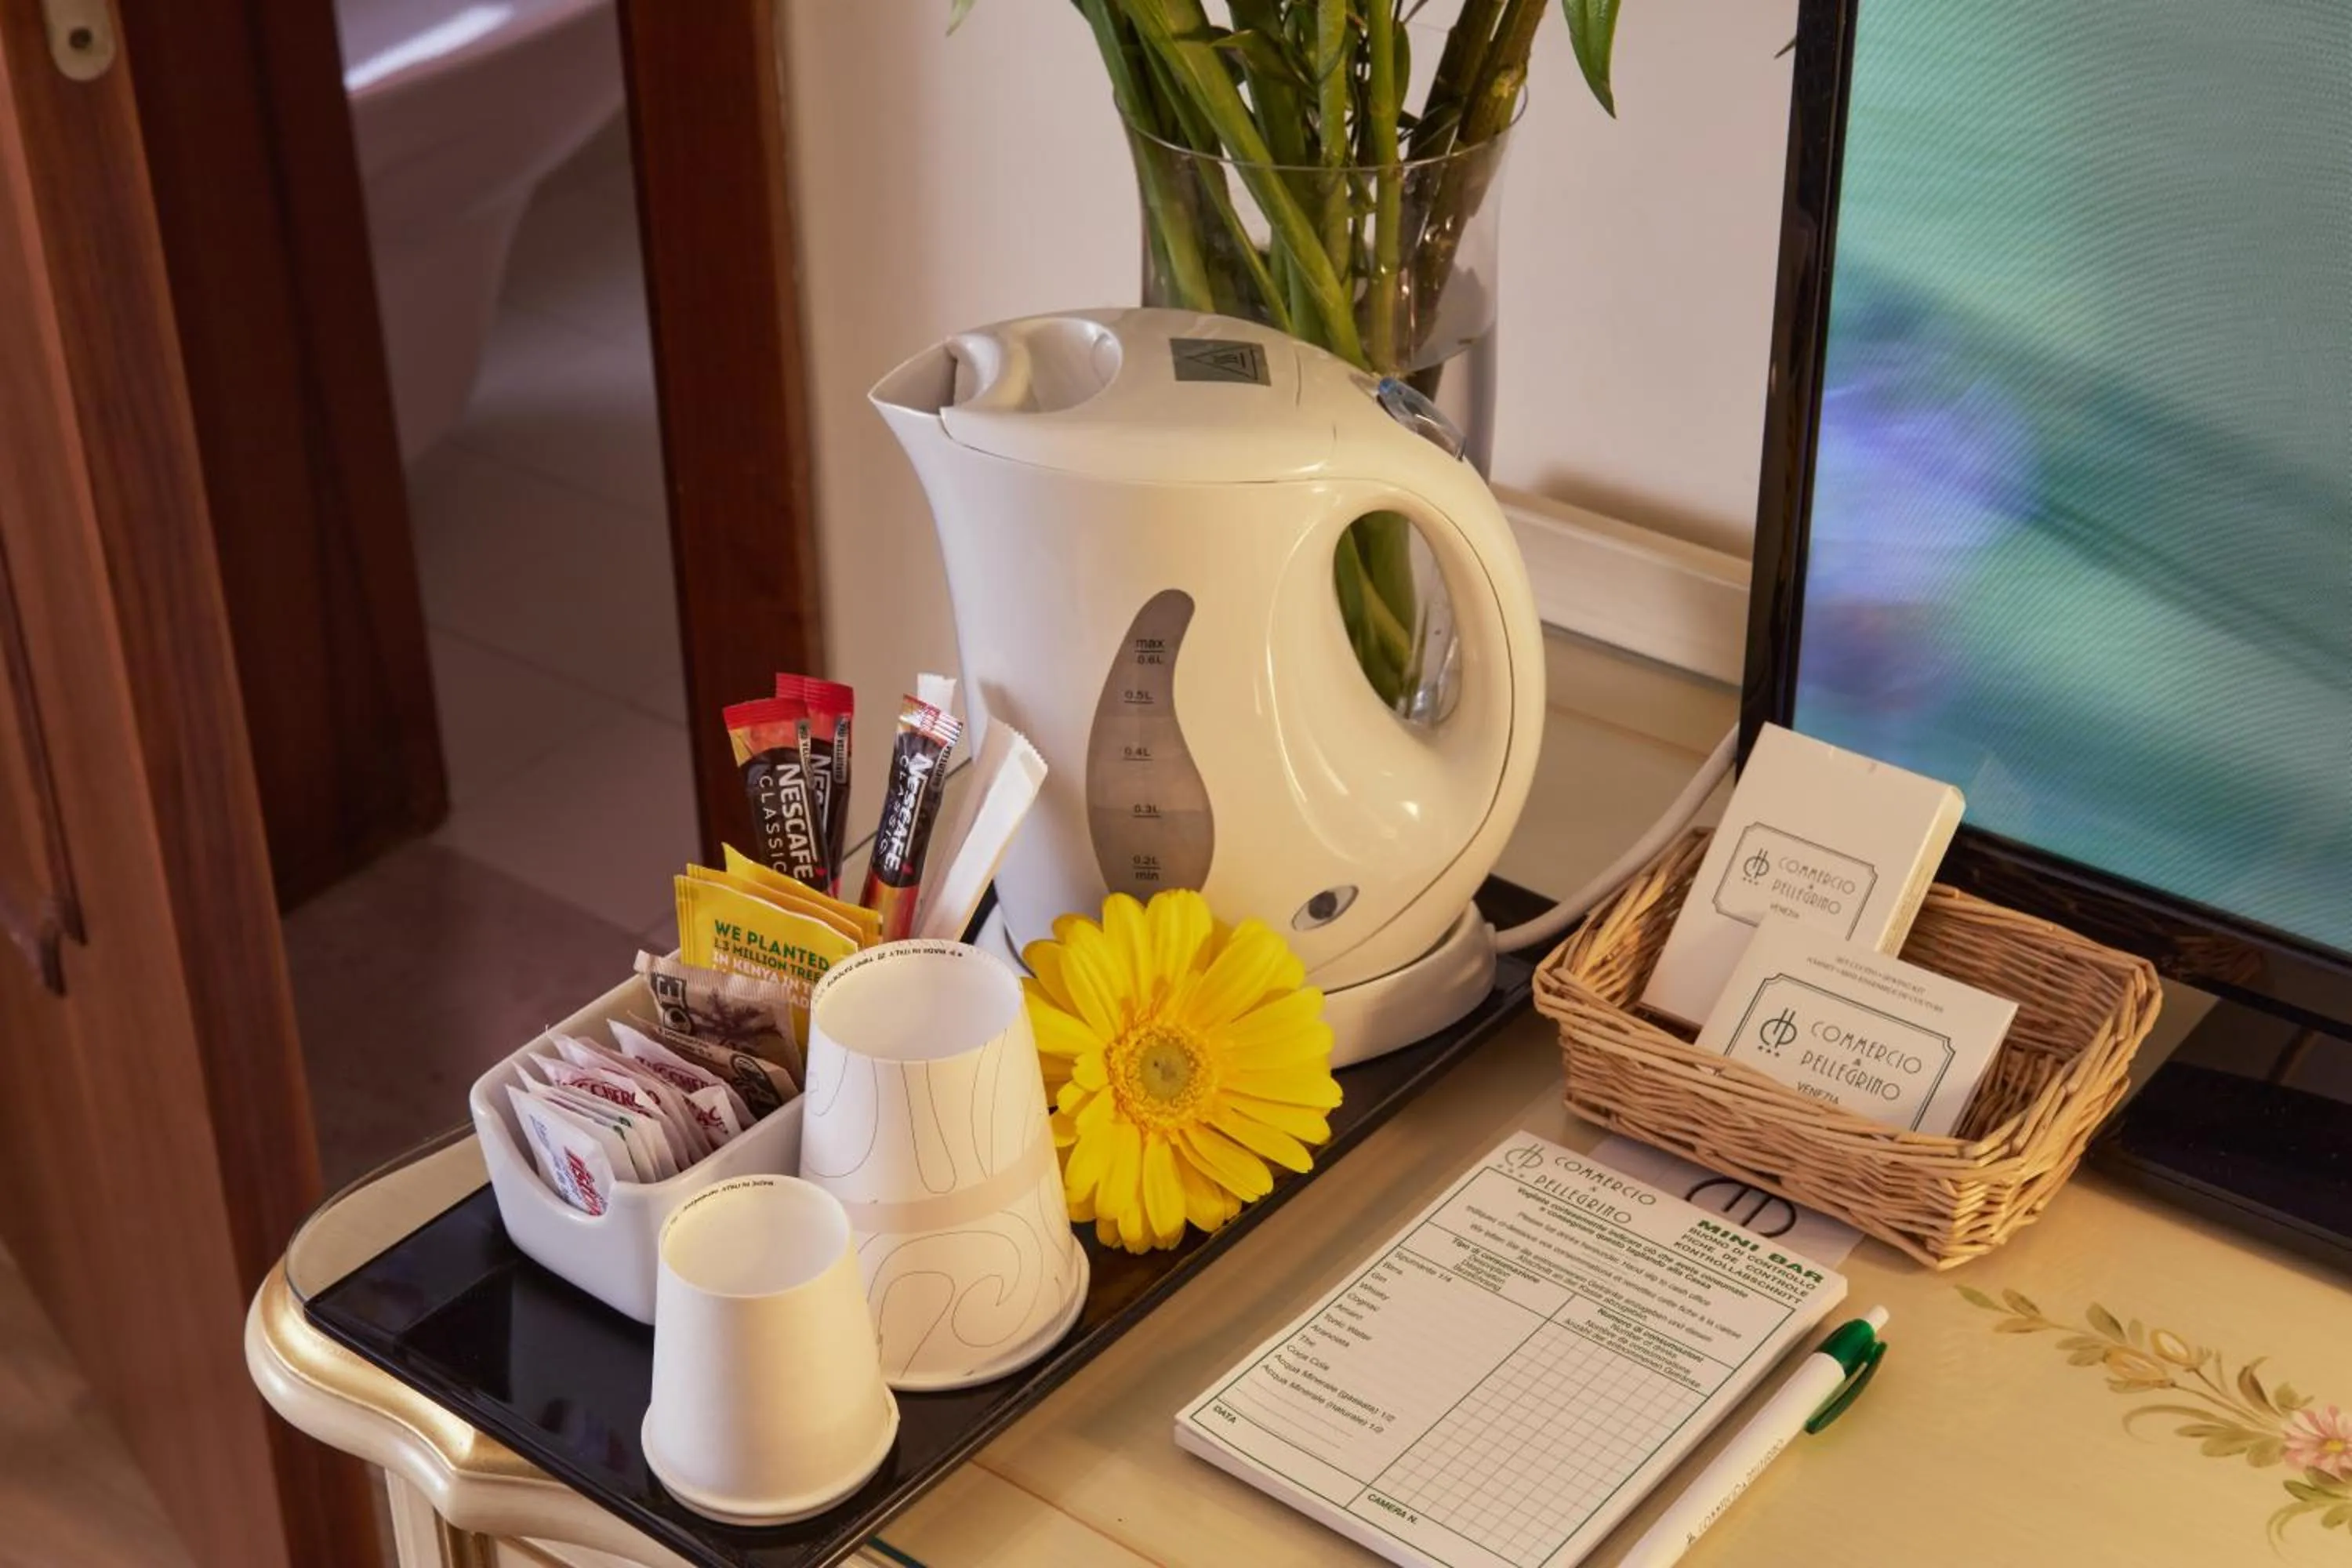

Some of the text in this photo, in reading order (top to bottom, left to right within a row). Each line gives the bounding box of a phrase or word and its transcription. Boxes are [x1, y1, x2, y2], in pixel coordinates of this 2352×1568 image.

[1136, 638, 1164, 648] max
[879, 755, 909, 854] CLASSIC
[760, 775, 787, 873] CLASSIC
[1135, 870, 1160, 880] min
[1778, 857, 1856, 895] COMMERCIO
[1772, 879, 1842, 915] PELLEGRINO
[715, 920, 829, 971] WE PLANTED
[732, 946, 786, 970] MILLION
[790, 965, 821, 982] TREE
[1811, 1021, 1922, 1074] COMMERCIO
[1798, 1081, 1839, 1105] VENEZIA
[1801, 1050, 1900, 1101] PELLEGRINO
[1552, 1155, 1657, 1206] COMMERCIO
[1534, 1174, 1635, 1225] PELLEGRINO
[1680, 1234, 1809, 1296] FICHE DE CONTROLE
[1687, 1227, 1730, 1248] BUONO
[1746, 1255, 1817, 1289] CONTROLLO
[1697, 1220, 1825, 1285] MINI BAR
[1370, 1272, 1388, 1283] Gin
[1672, 1241, 1803, 1304] KONTROLLABSCHNITT
[1346, 1327, 1372, 1341] Water
[1258, 1364, 1291, 1384] Acqua
[1272, 1354, 1303, 1373] Acqua
[1284, 1345, 1330, 1370] Coca Cola
[1210, 1406, 1238, 1423] DATA
[1367, 1493, 1406, 1518] CAMERA
